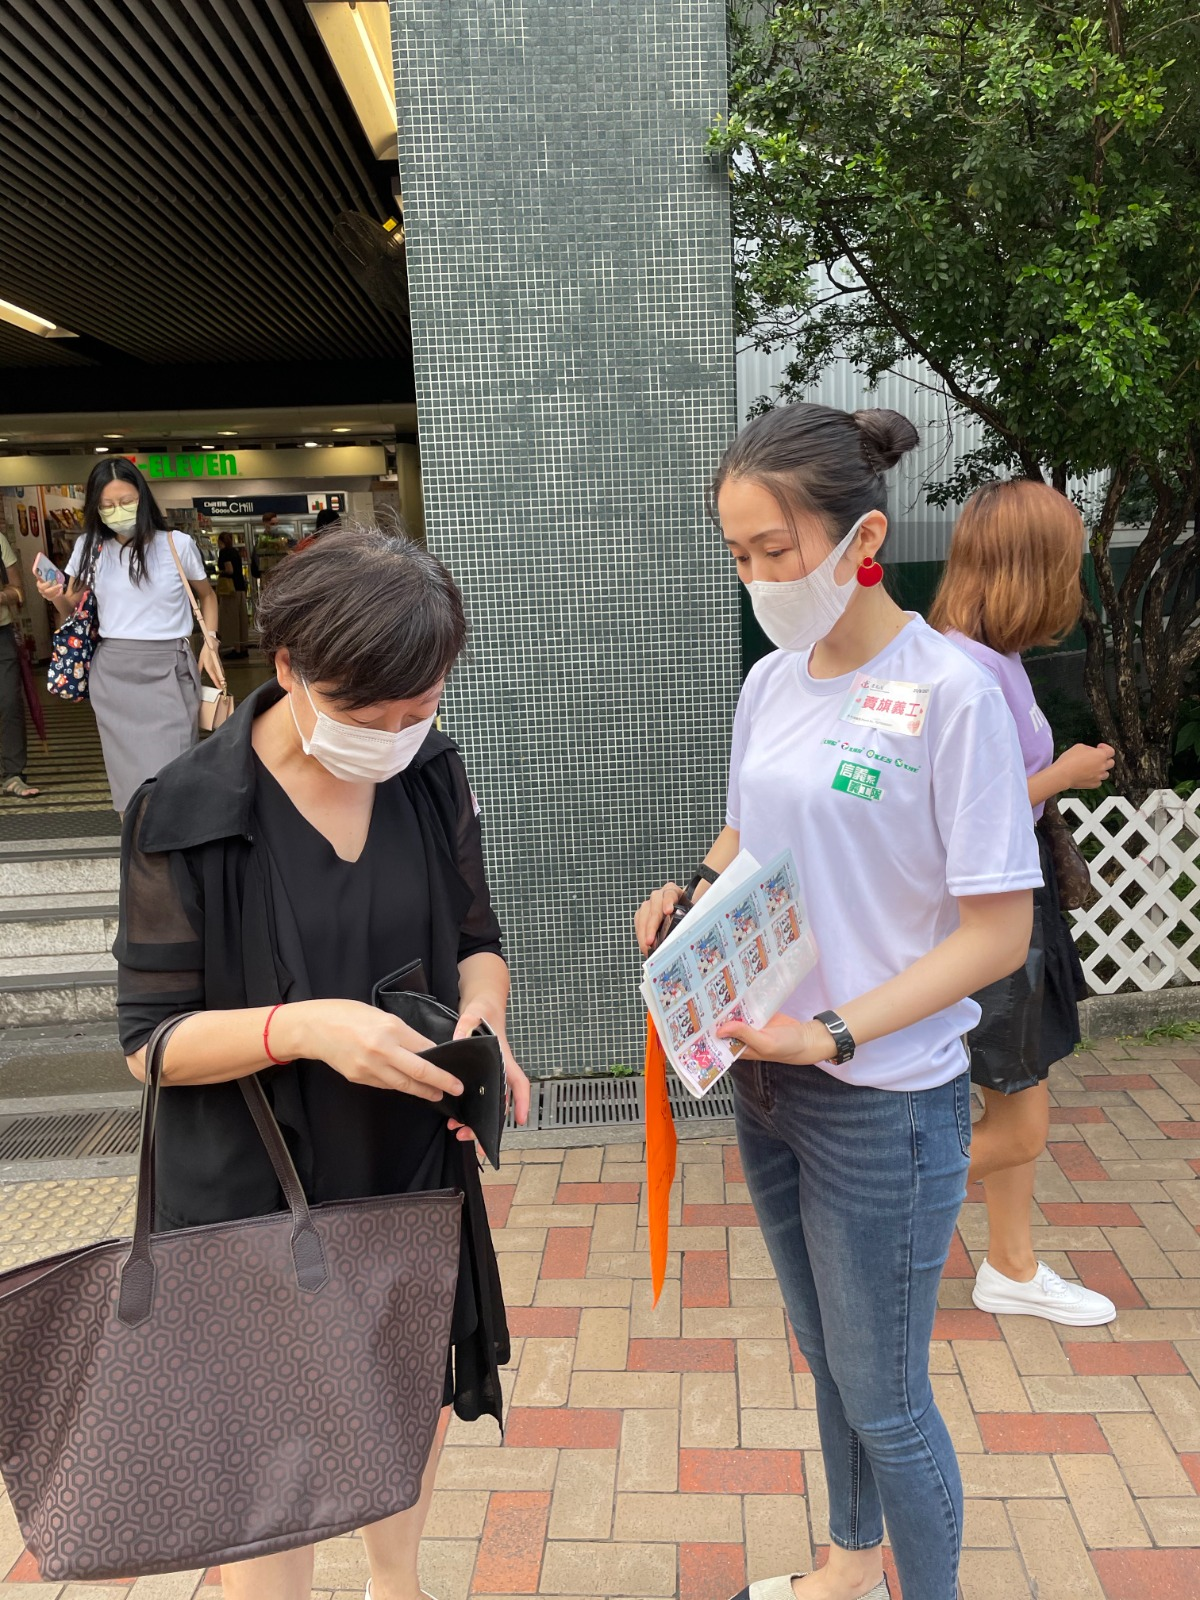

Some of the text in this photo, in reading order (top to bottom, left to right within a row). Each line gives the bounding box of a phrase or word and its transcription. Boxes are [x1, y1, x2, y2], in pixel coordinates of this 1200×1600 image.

[229, 502, 254, 513] Chill
[862, 695, 920, 718] 賣旗義工
